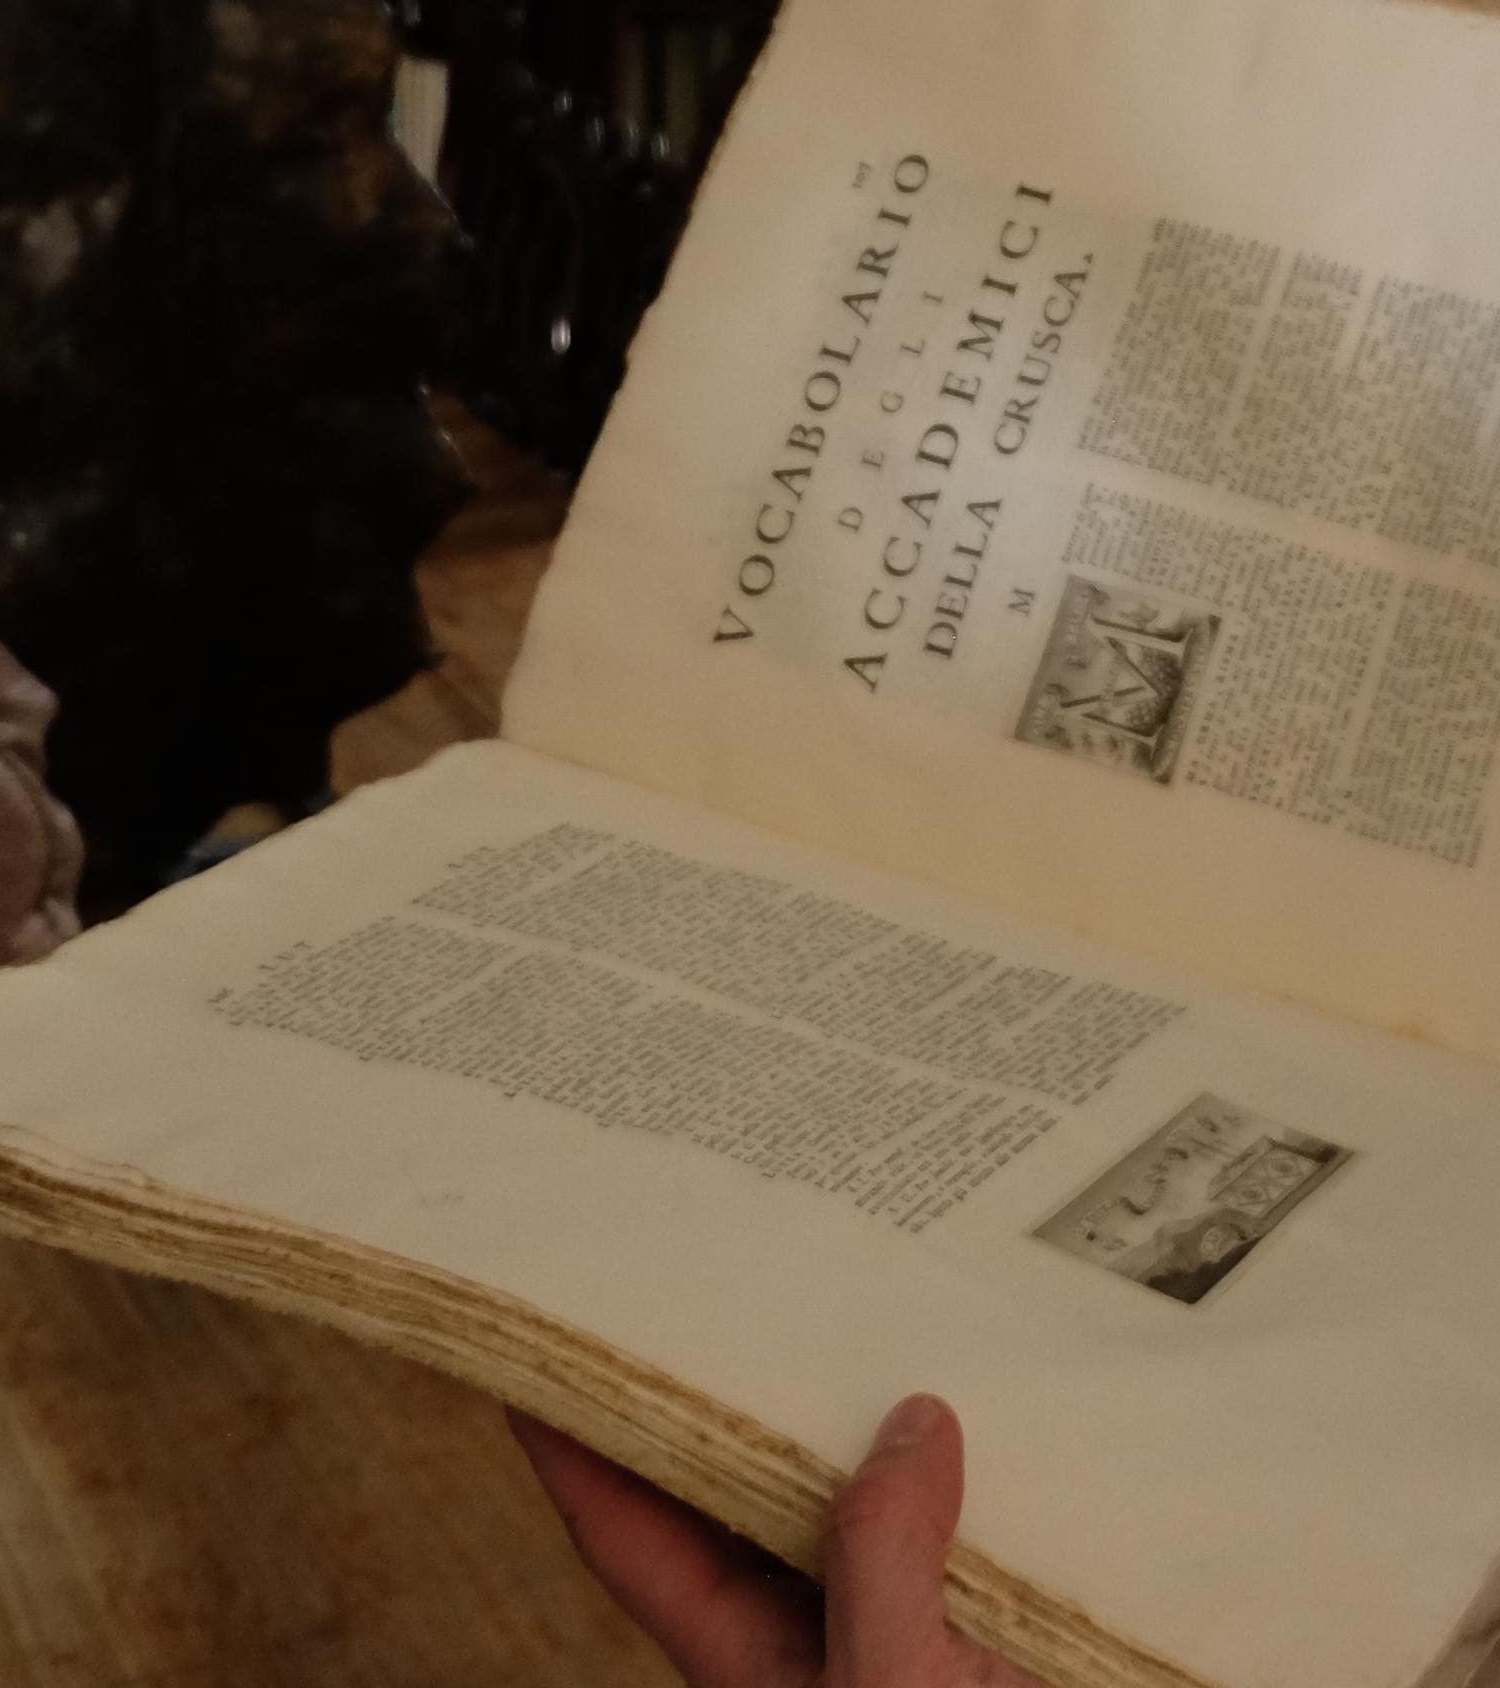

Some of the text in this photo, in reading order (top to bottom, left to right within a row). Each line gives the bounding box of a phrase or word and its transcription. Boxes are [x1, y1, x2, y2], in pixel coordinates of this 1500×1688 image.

[712, 153, 930, 645] VOCABOLARIO
[843, 180, 1054, 694] ACCADEMICI
[923, 252, 1094, 661] DELLA CRUSCA.
[1008, 586, 1037, 617] M
